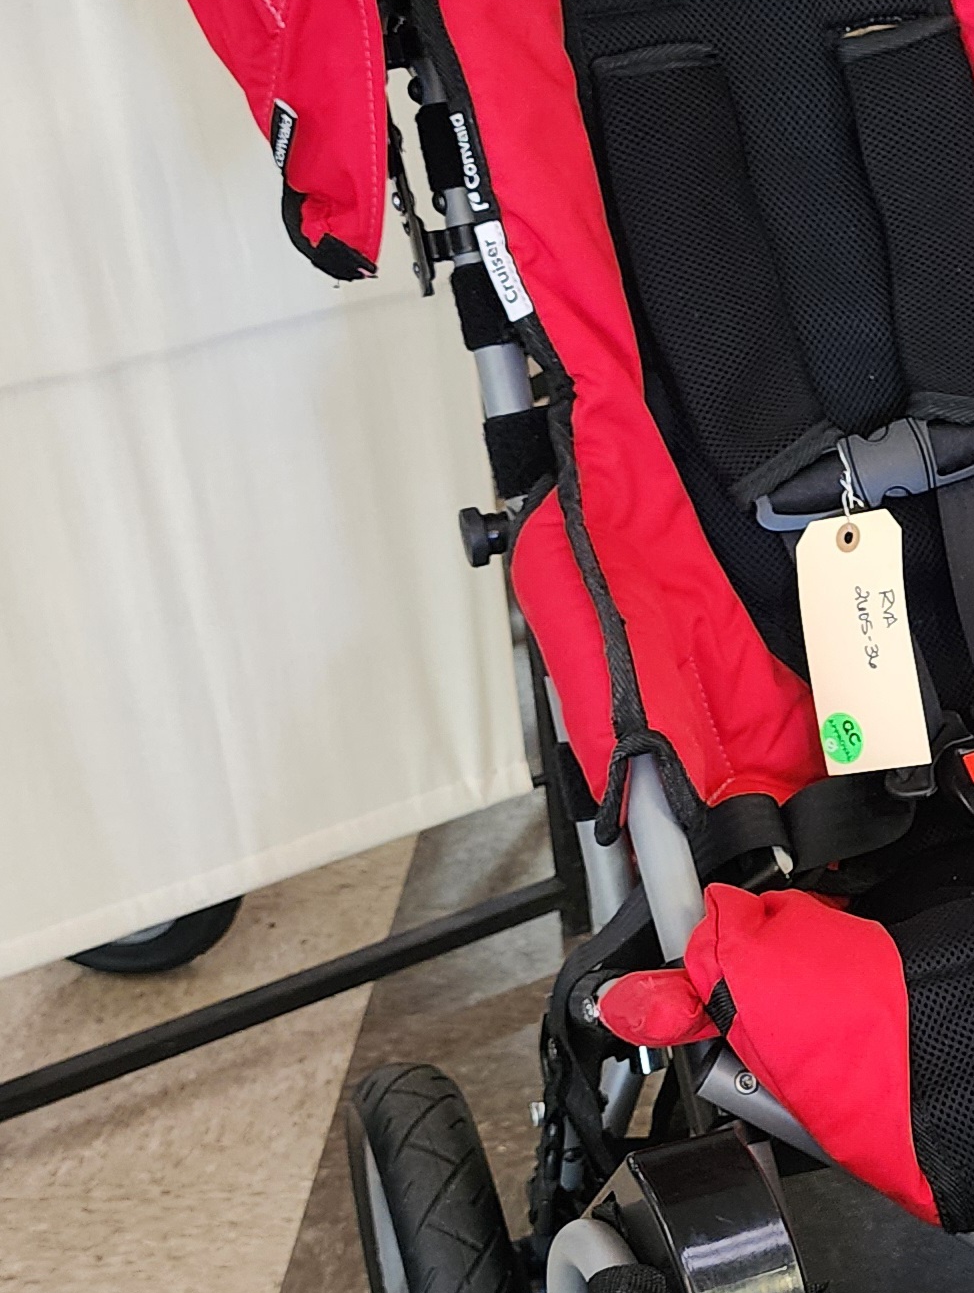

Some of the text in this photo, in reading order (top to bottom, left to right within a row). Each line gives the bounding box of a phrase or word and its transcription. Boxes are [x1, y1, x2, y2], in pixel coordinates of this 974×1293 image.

[449, 112, 481, 190] Convaid
[484, 239, 519, 304] Cruiser
[878, 588, 898, 628] RVA
